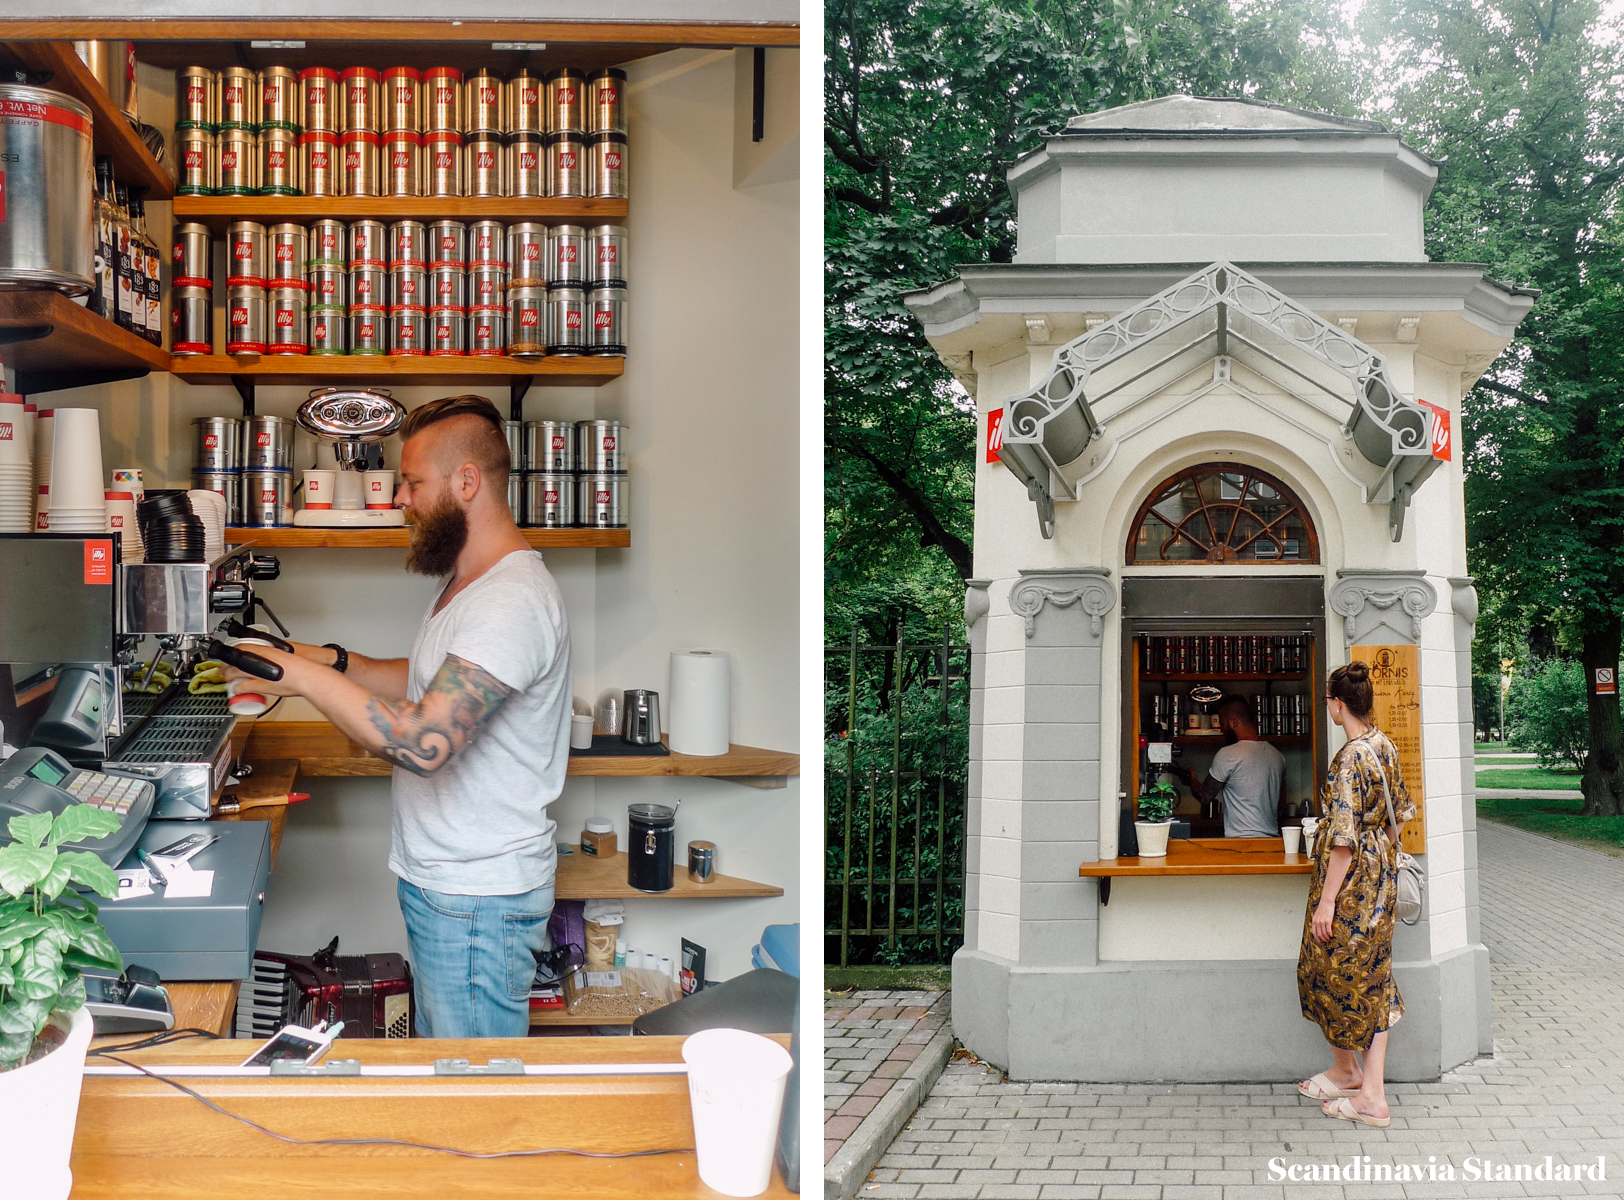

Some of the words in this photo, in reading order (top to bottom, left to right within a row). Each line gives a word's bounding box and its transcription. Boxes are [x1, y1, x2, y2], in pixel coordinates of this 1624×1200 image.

[189, 88, 204, 101] illy
[227, 88, 241, 102] illy
[265, 88, 278, 102] illy
[310, 89, 324, 102] illy
[352, 89, 366, 101] illy
[397, 89, 411, 102] illy
[438, 89, 452, 102] illy
[482, 90, 495, 102] illy
[524, 90, 537, 103] illy
[559, 90, 574, 102] illy
[601, 89, 615, 102] illy
[27, 104, 47, 115] Net
[186, 153, 201, 166] illy
[223, 153, 236, 167] illy
[269, 154, 284, 166] illy
[313, 154, 327, 166] illy
[347, 154, 360, 167] illy
[394, 154, 408, 166] illy
[437, 154, 451, 166] illy
[479, 154, 493, 166] illy
[522, 154, 536, 167] illy
[561, 154, 575, 167] illy
[607, 154, 620, 167] illy
[236, 243, 251, 258] illy
[277, 246, 292, 260] illy
[524, 245, 538, 258] illy
[560, 248, 575, 260] illy
[601, 248, 615, 260] illy
[233, 310, 246, 323] illy
[278, 312, 292, 324] illy
[522, 311, 536, 324] illy
[568, 313, 580, 326] illy
[596, 313, 610, 326] illy
[205, 436, 218, 447] illy
[258, 434, 270, 445] illy
[553, 438, 564, 448] illy
[604, 438, 614, 449] illy
[262, 491, 276, 502] illy
[546, 492, 557, 502] illy
[598, 492, 610, 502] illy
